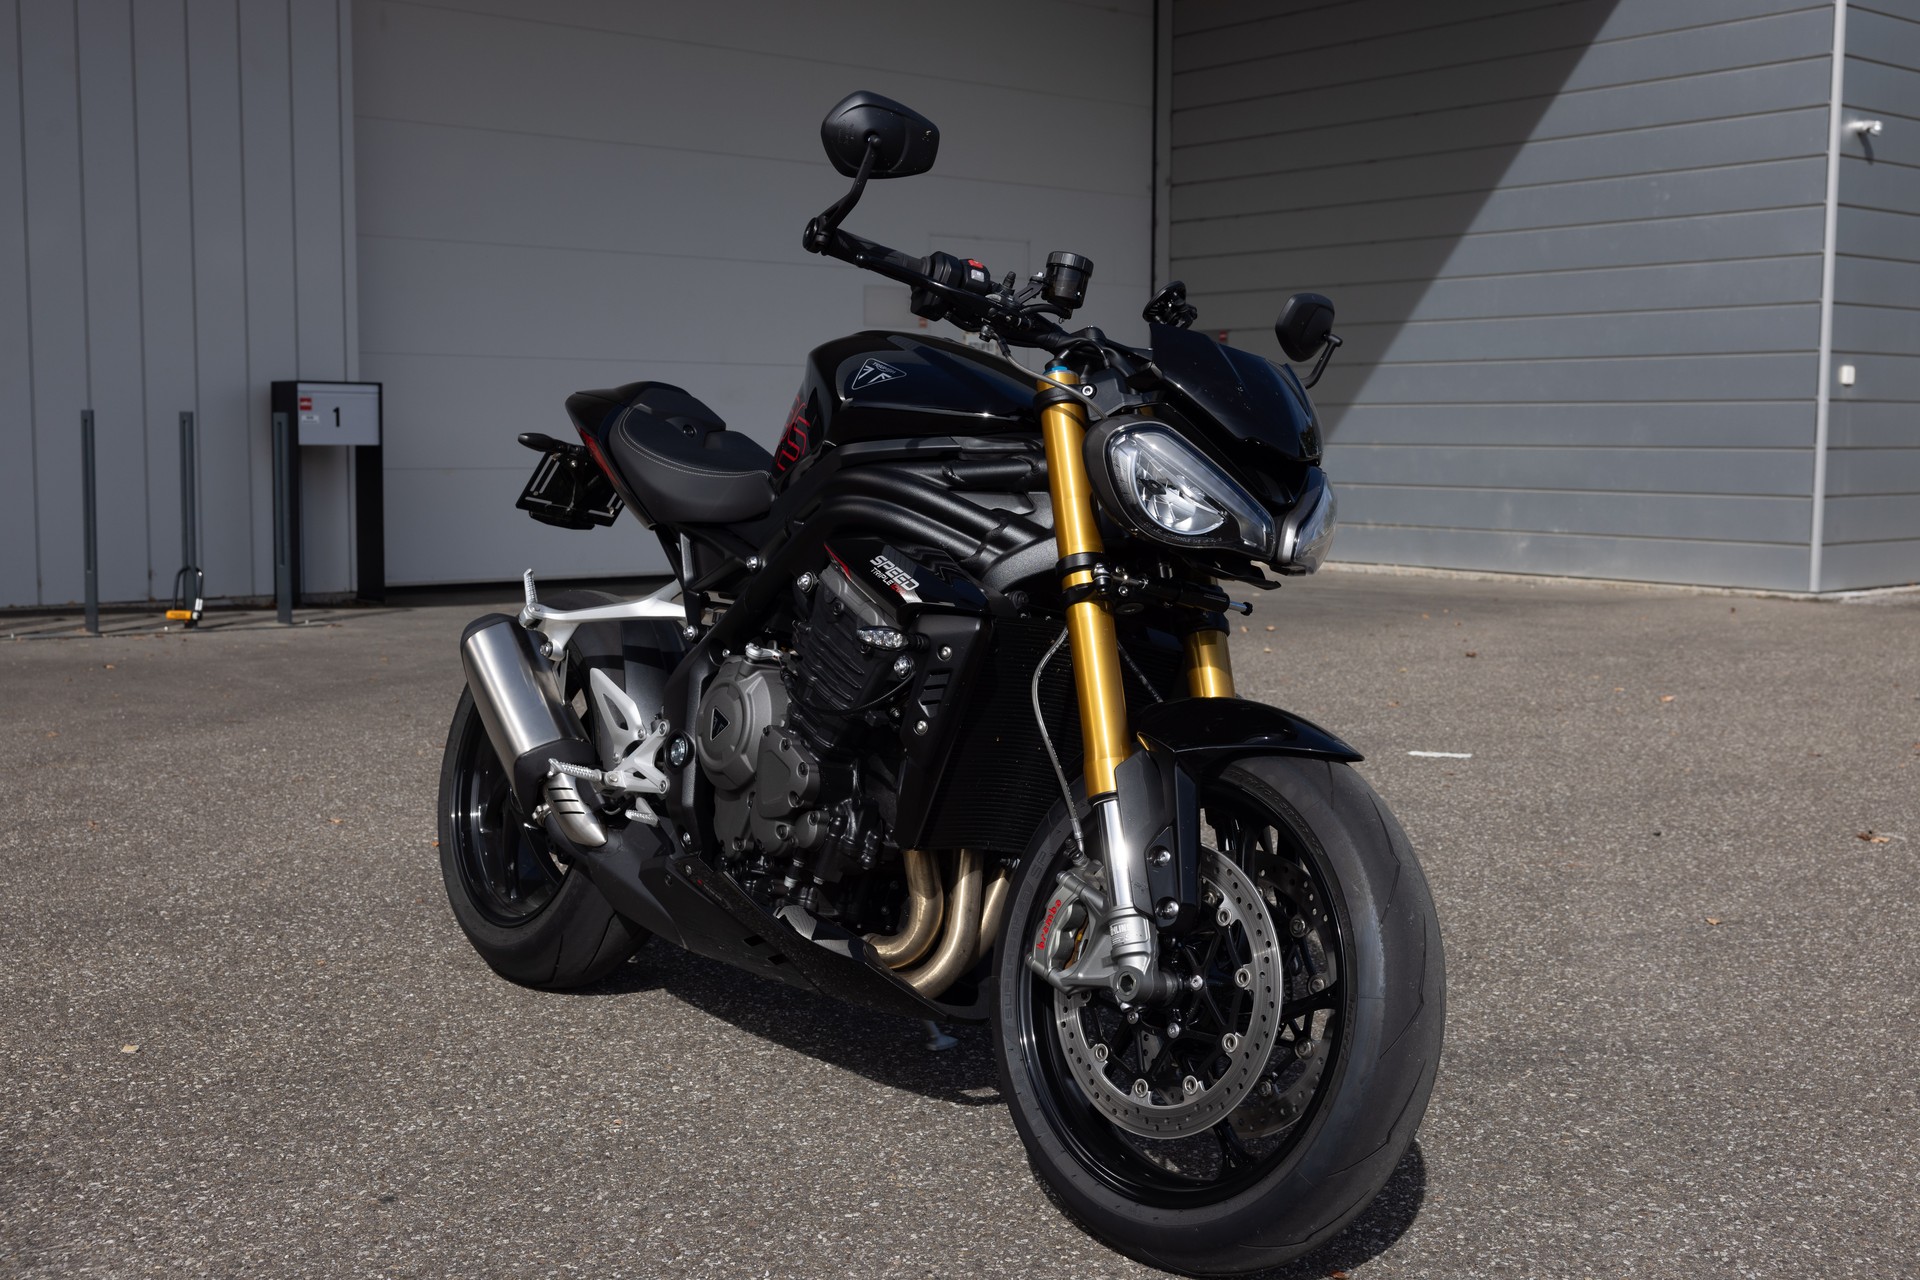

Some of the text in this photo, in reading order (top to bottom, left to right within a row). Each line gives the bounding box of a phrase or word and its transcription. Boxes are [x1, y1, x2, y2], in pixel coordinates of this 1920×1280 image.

[333, 406, 341, 428] 1
[869, 555, 920, 591] SPEED
[870, 566, 894, 586] TRIPLE
[1036, 899, 1062, 951] brembo
